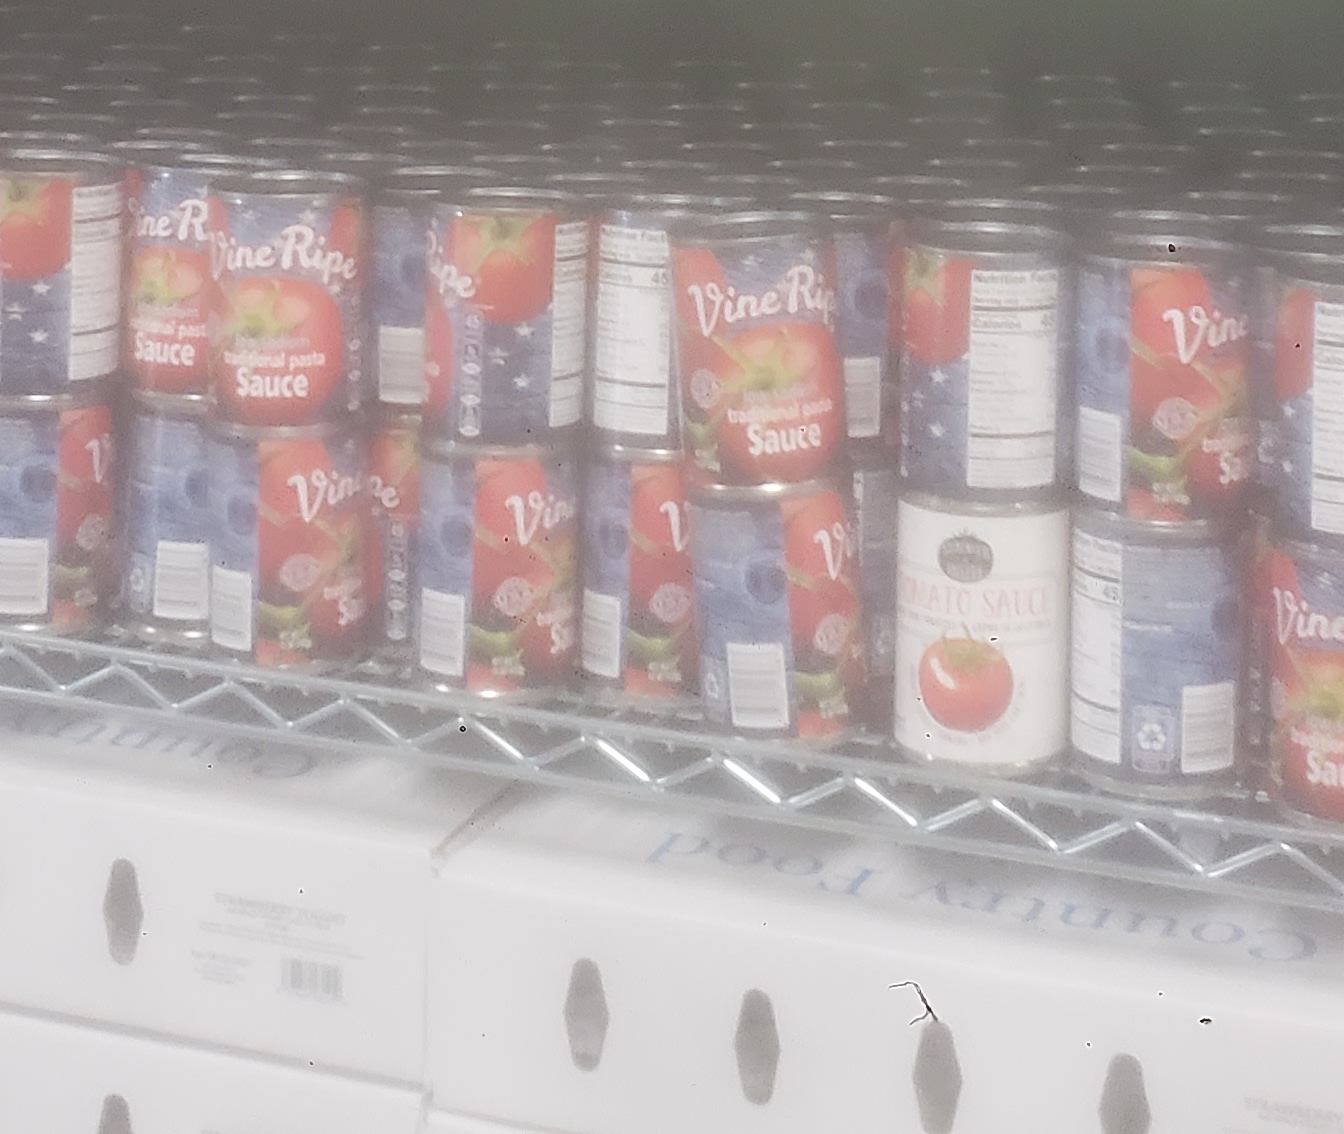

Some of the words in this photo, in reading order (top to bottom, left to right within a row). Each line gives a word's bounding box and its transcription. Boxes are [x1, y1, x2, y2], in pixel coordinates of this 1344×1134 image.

[209, 230, 275, 281] Vine
[277, 224, 357, 284] Ripe
[688, 280, 781, 339] Vine
[134, 331, 196, 367] Sauce
[236, 366, 309, 399] Sauce
[747, 421, 822, 457] Sauce
[650, 830, 873, 899] Food
[902, 879, 1320, 964] Country
